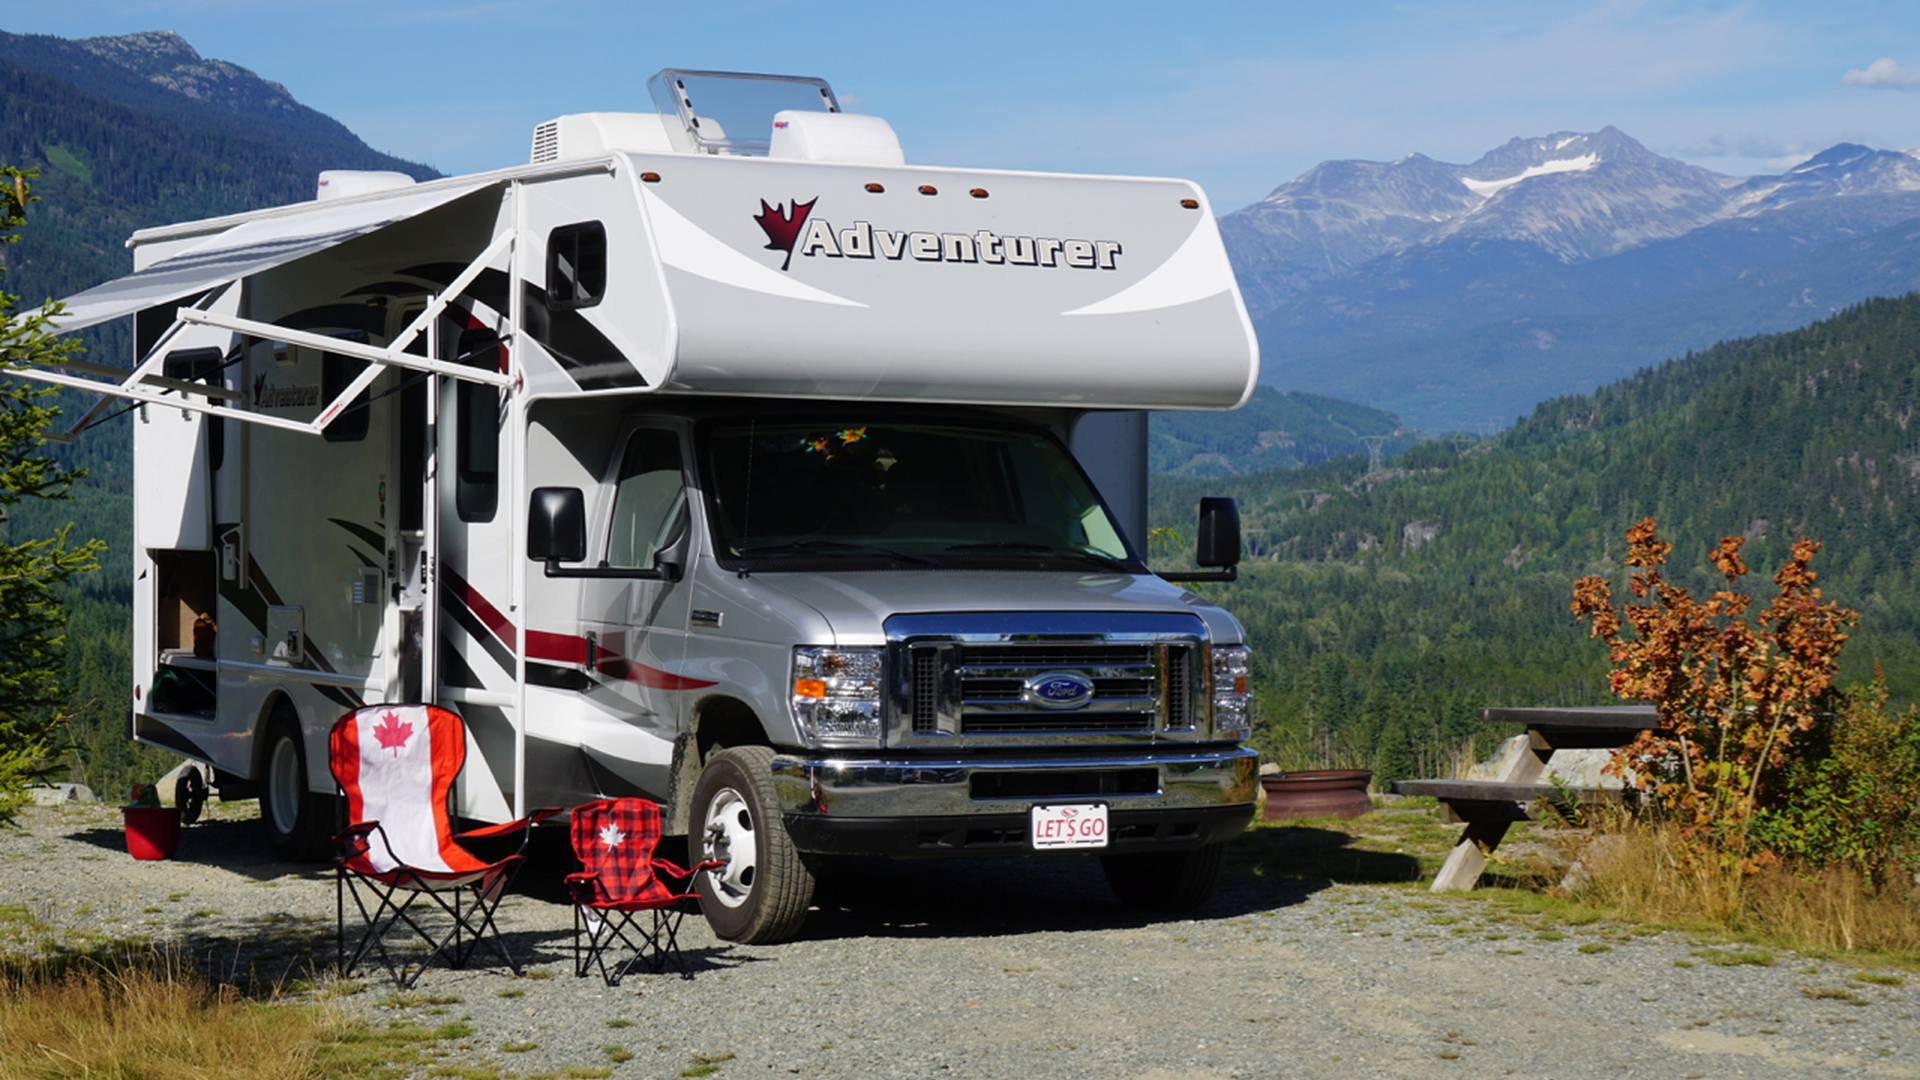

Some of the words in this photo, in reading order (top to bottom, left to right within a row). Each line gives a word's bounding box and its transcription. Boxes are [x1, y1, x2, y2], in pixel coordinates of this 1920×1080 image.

[801, 218, 1122, 270] Adventurer
[1047, 681, 1078, 697] Ford
[1036, 818, 1076, 838] LET'S
[1080, 817, 1105, 837] GO
